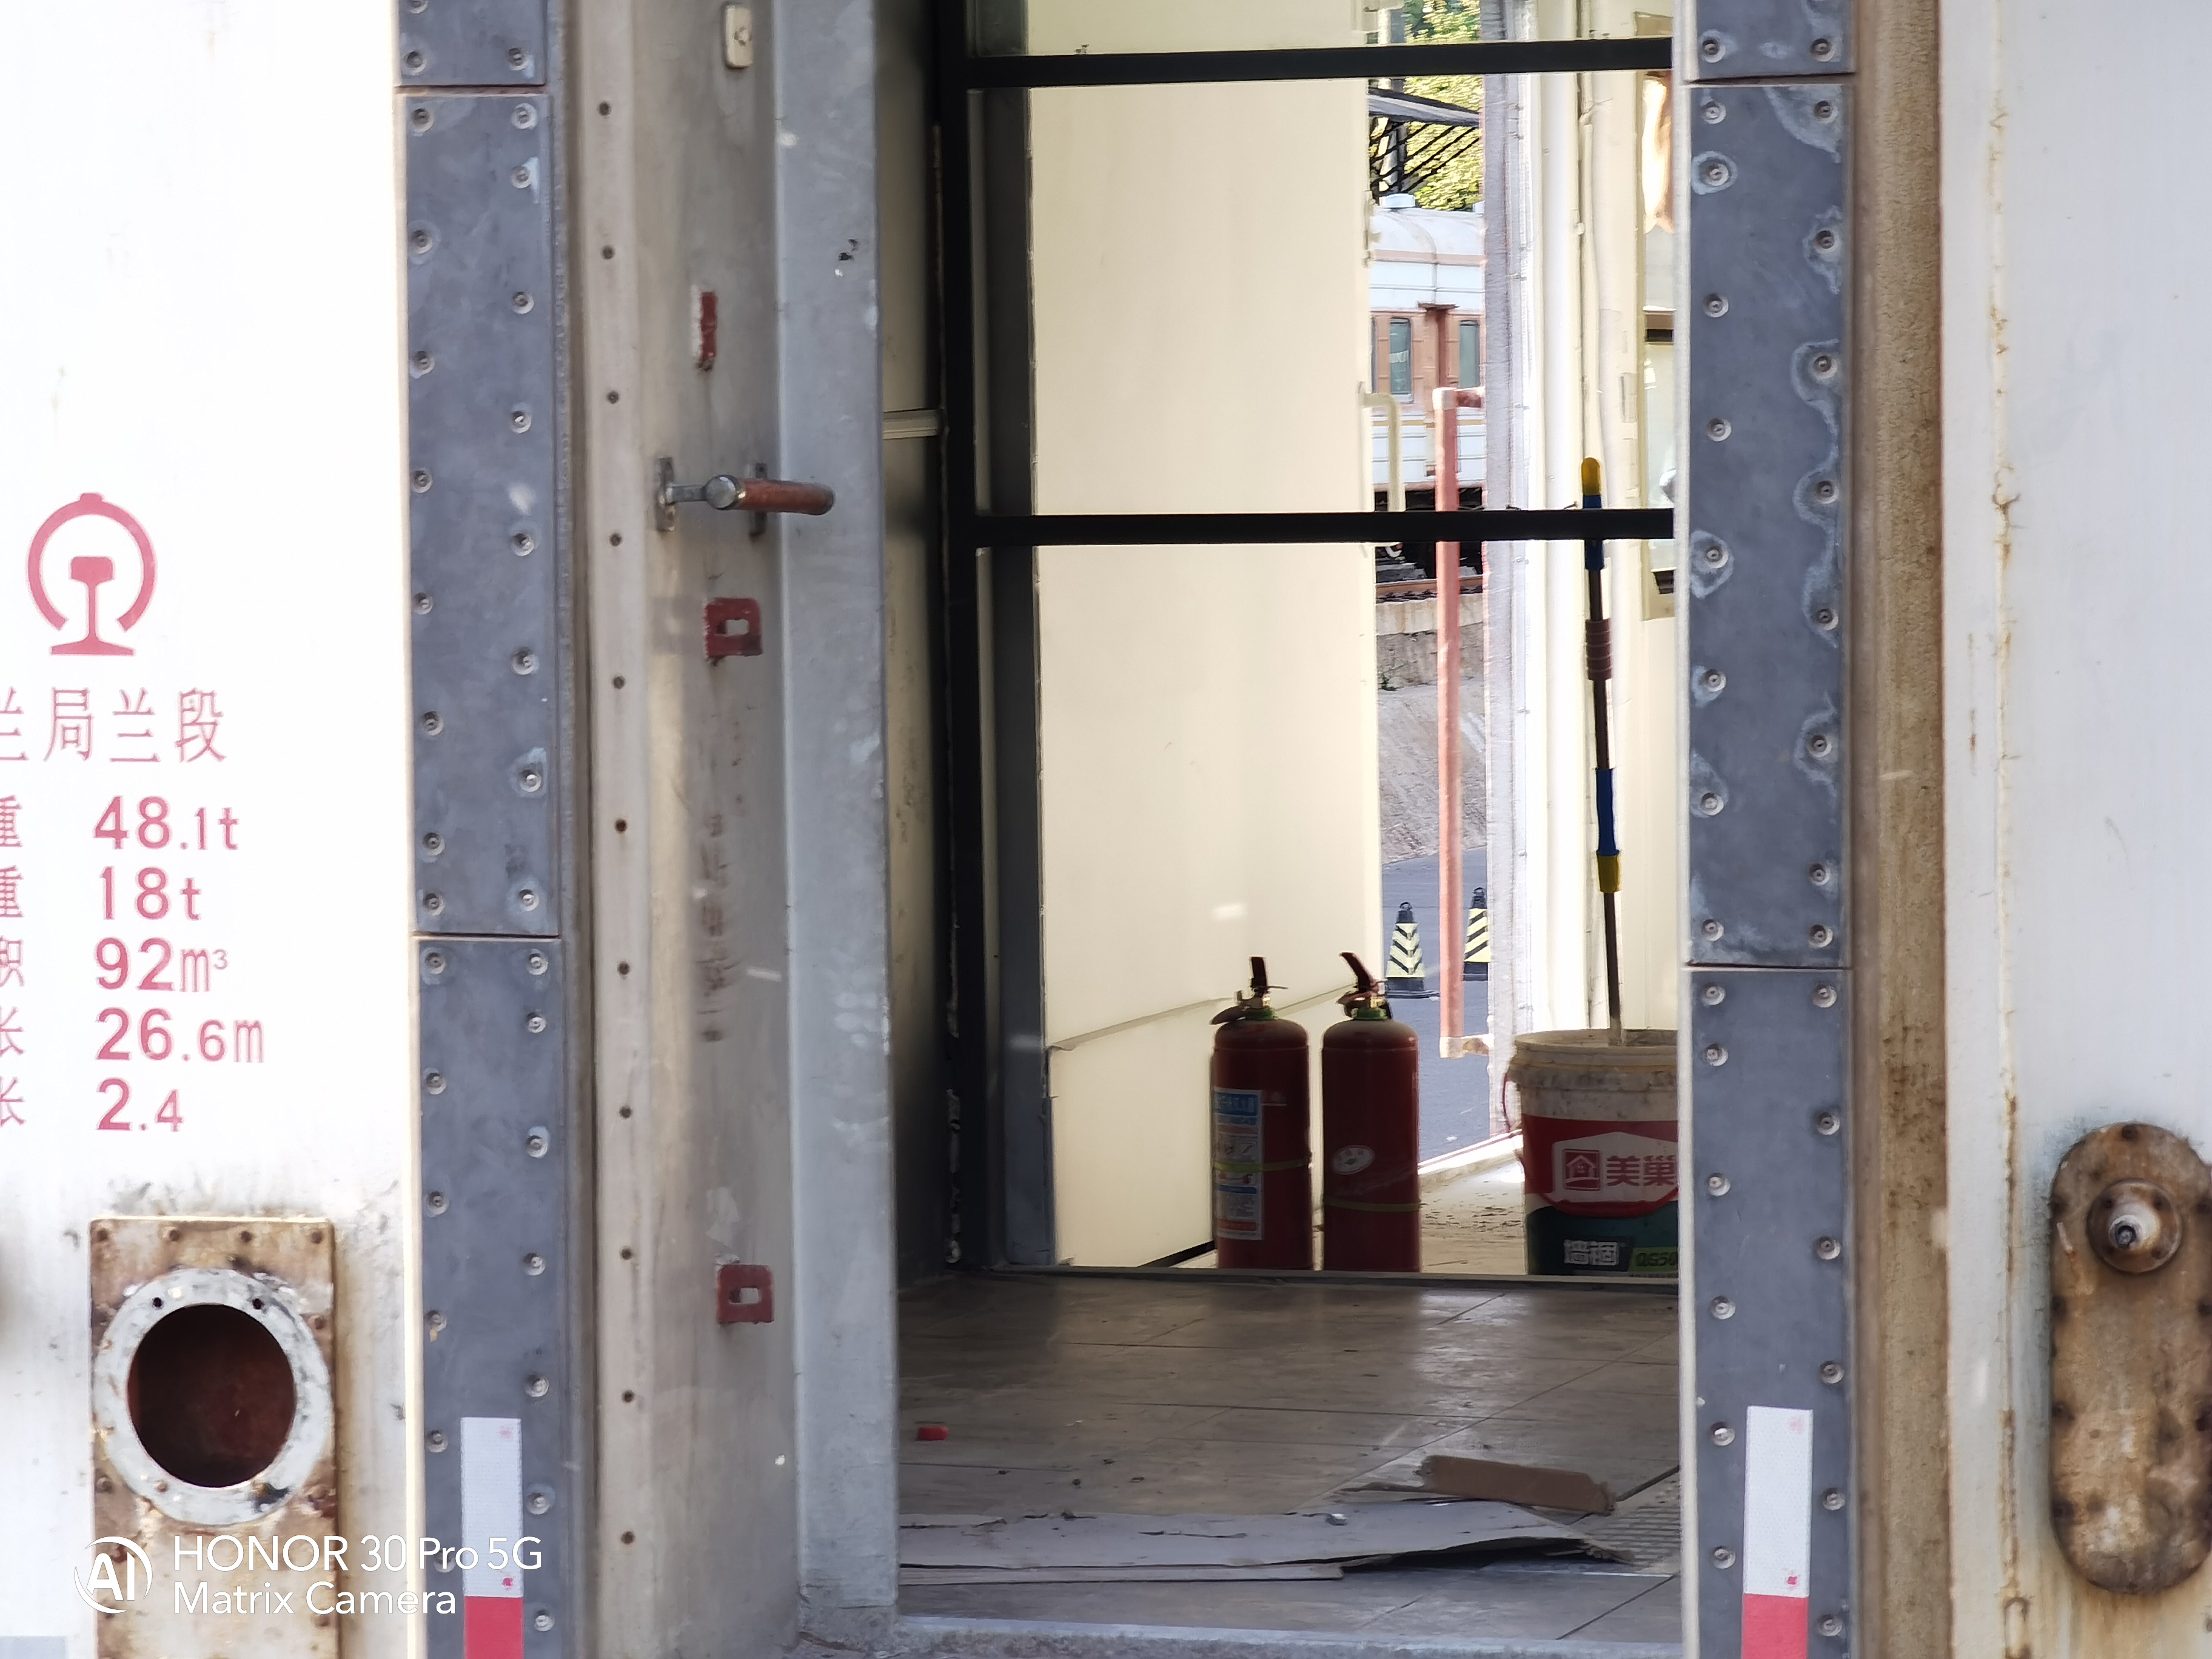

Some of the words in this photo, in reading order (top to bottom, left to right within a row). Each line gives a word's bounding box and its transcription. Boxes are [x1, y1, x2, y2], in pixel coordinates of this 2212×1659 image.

[93, 795, 239, 850] 48.1t
[100, 866, 201, 920] 18t
[96, 1007, 264, 1062] 26.6m
[96, 1076, 184, 1132] 2.4
